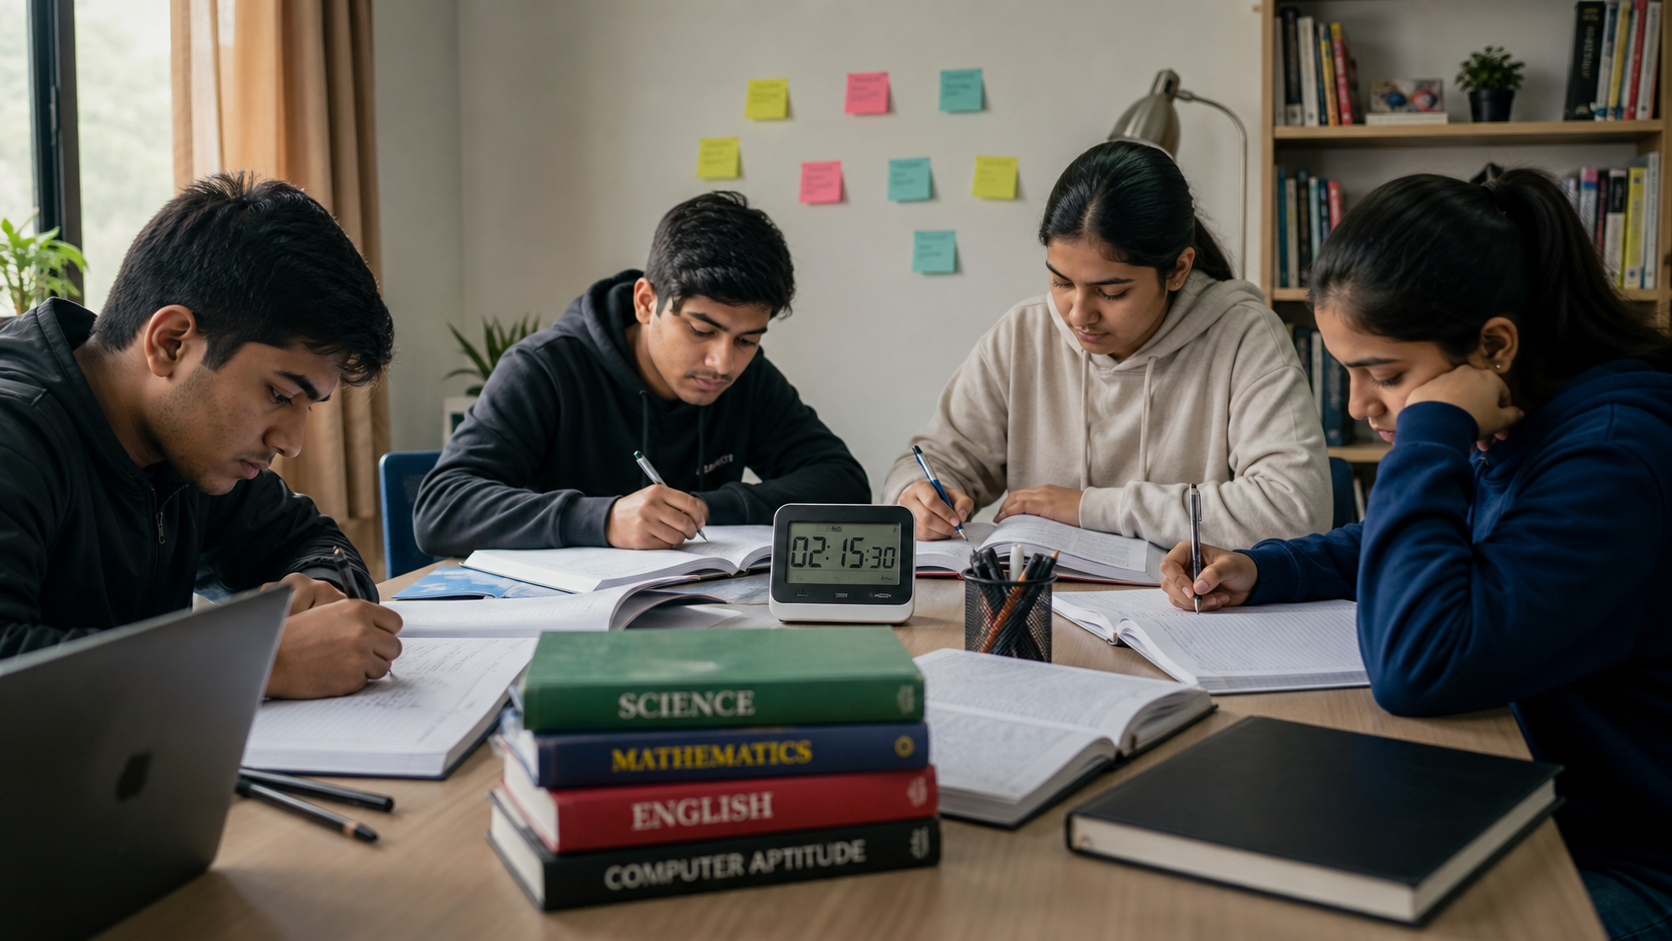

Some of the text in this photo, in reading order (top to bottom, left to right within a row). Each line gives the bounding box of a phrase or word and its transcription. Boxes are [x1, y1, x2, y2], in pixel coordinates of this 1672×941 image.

[790, 536, 896, 569] 02:15:30
[618, 690, 756, 719] SCIENCE
[611, 740, 813, 773] MATHEMATICS
[632, 791, 774, 831] ENGLISH
[604, 839, 868, 891] COMPUTER APTITUDE
